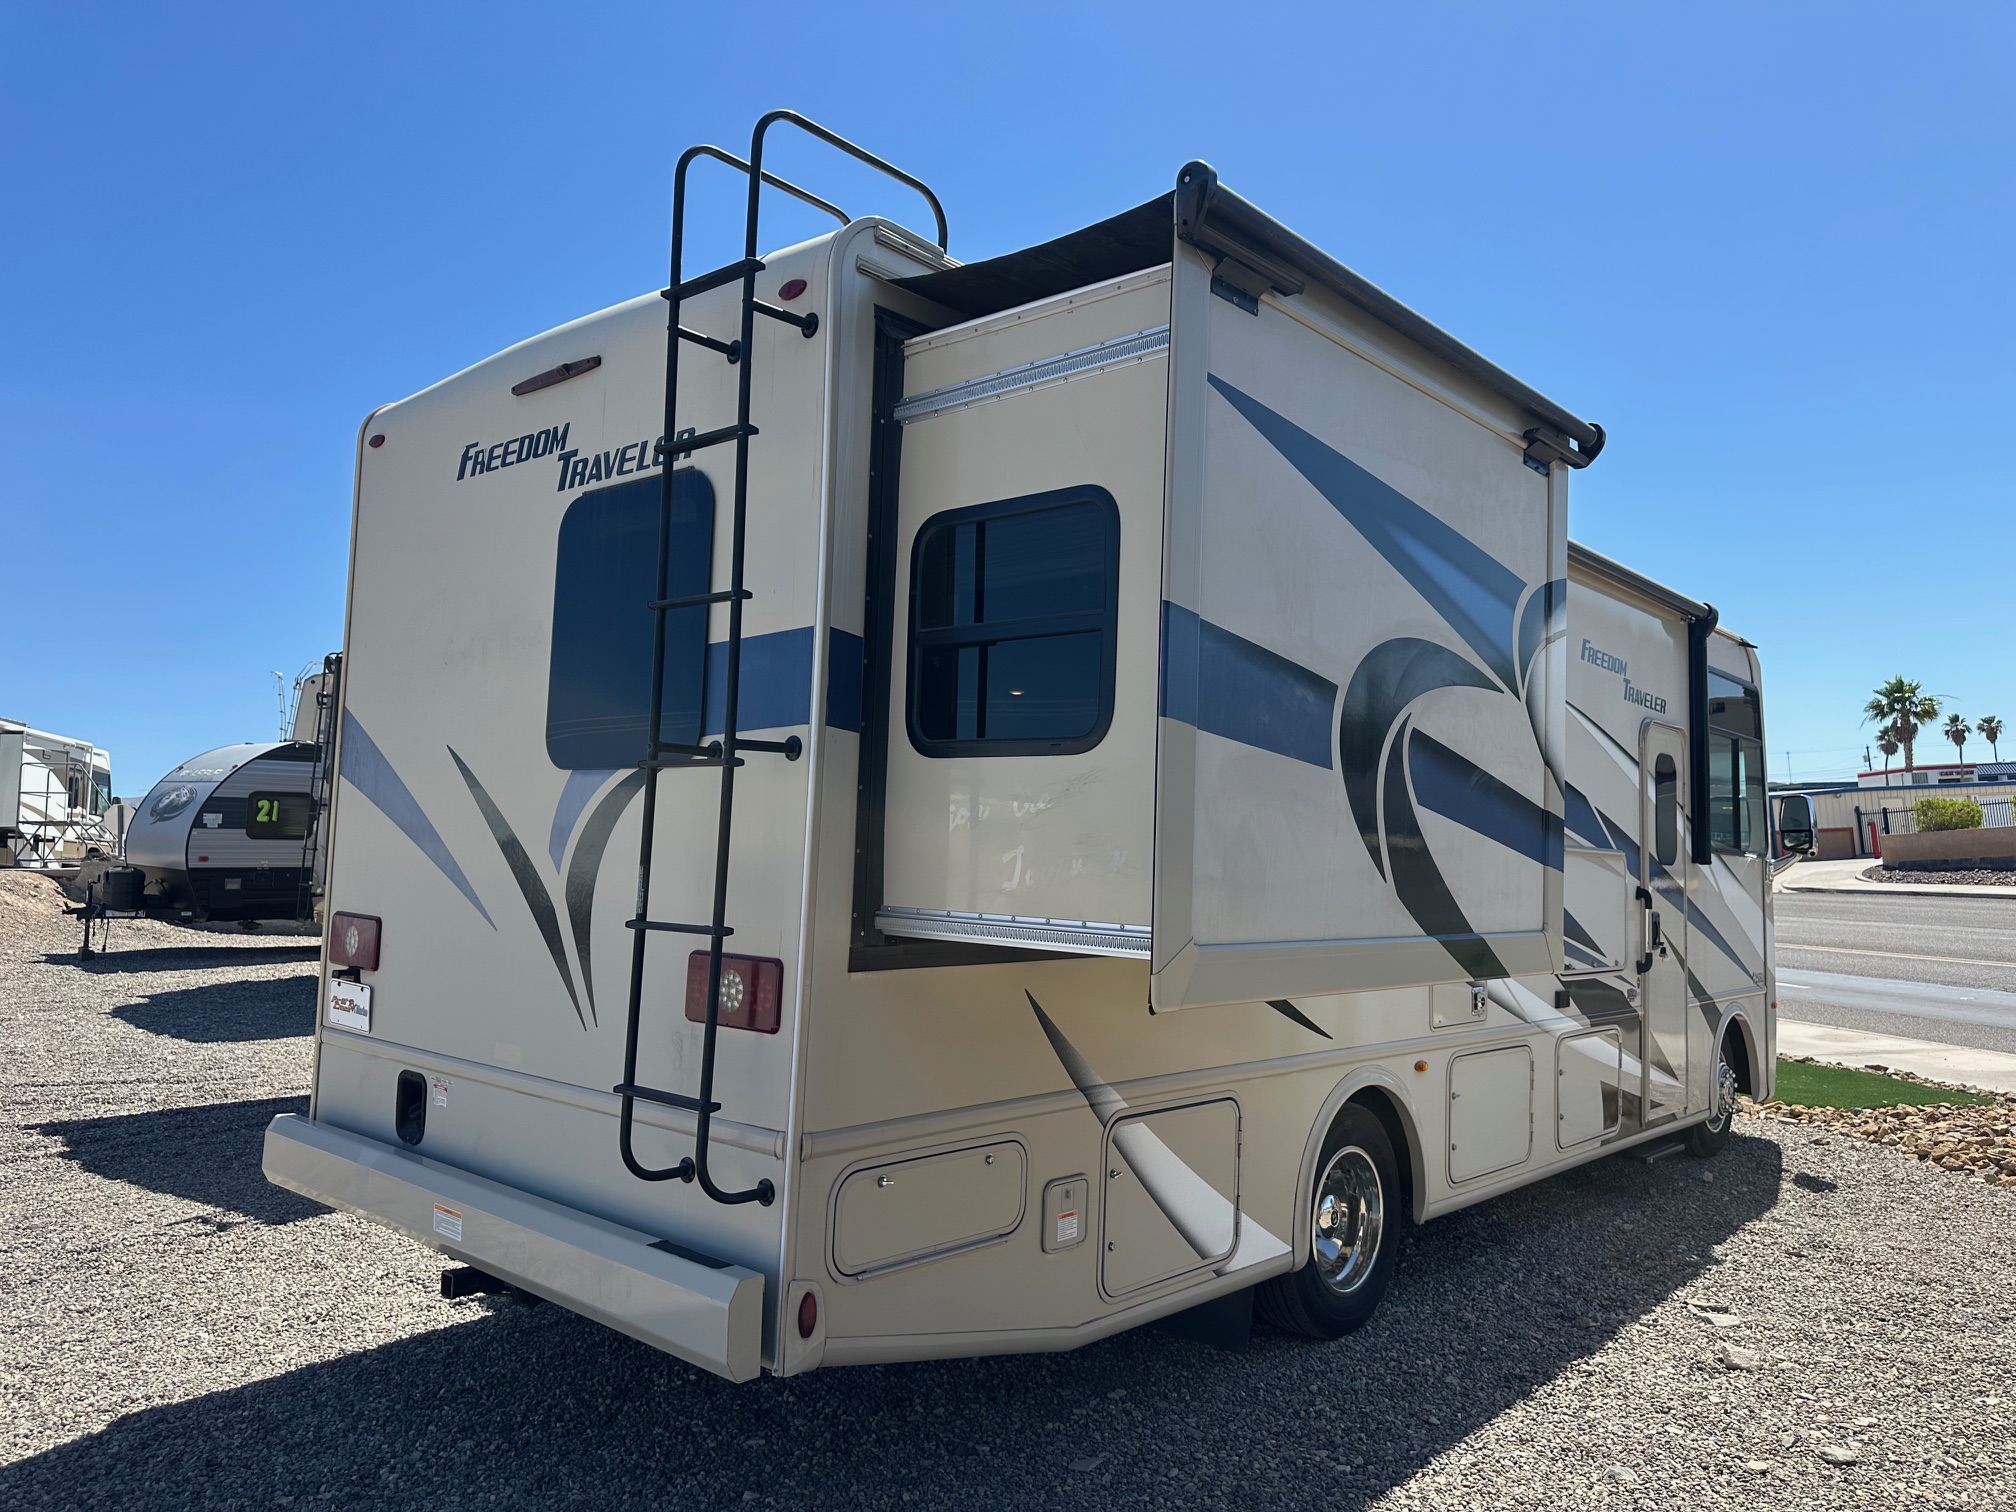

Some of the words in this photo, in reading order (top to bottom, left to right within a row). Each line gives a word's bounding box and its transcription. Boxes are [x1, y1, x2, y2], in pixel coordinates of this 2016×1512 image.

[456, 422, 571, 482] FREEDOM
[1581, 638, 1628, 677] FREEDOM
[1623, 678, 1667, 714] TRAVELER
[256, 799, 280, 822] 21
